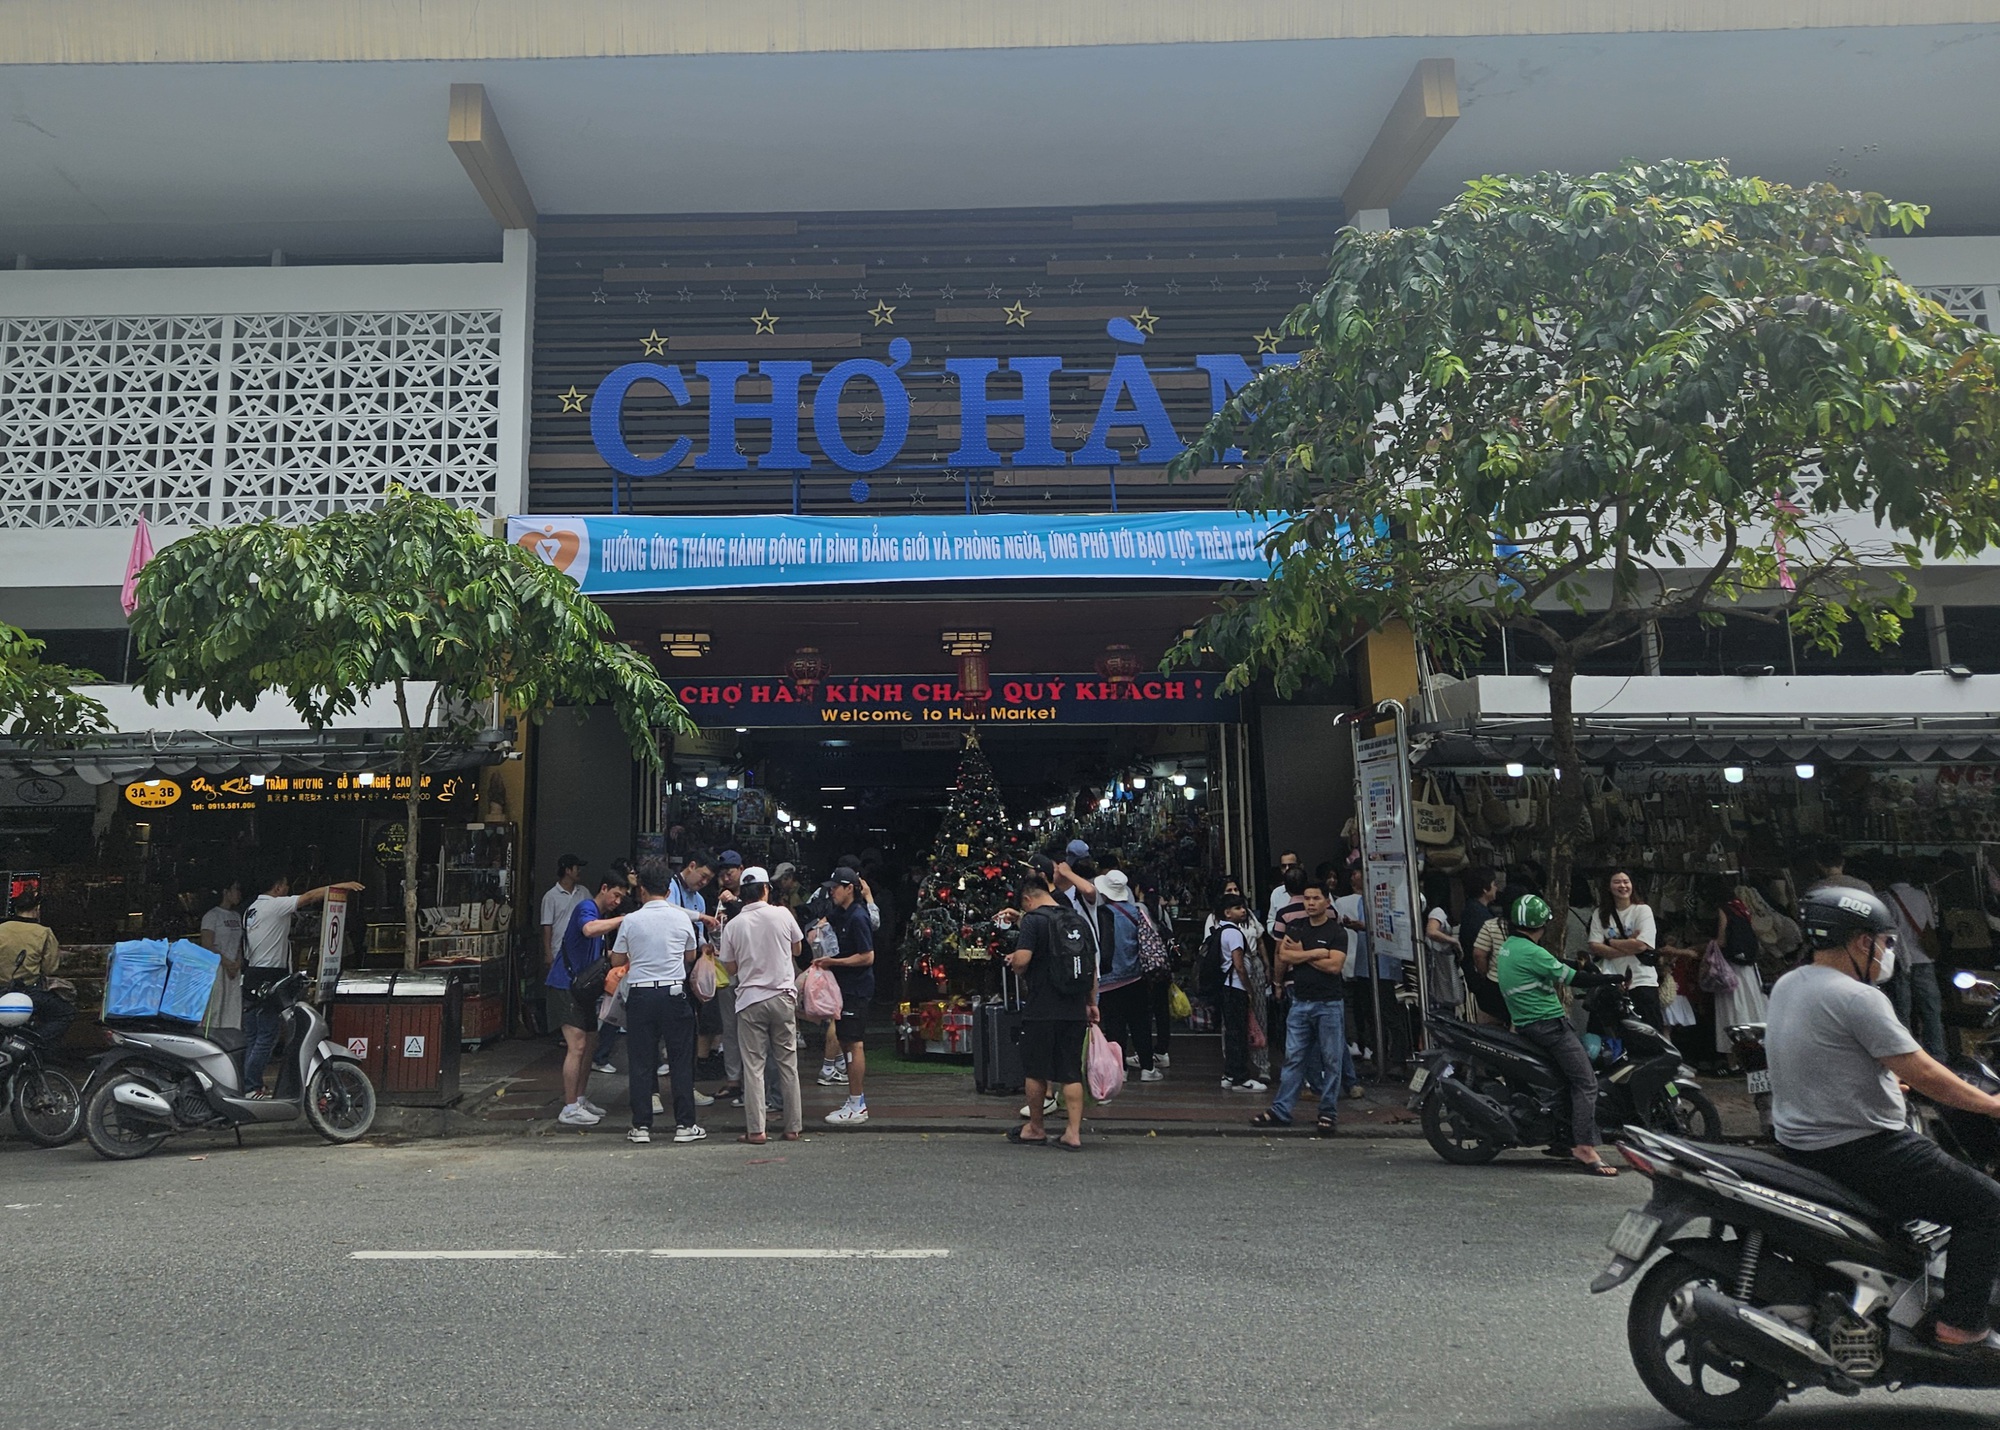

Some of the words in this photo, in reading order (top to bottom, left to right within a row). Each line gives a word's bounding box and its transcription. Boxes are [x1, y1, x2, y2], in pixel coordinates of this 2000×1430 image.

[590, 337, 913, 503] CHỢ
[601, 528, 647, 573] HƯỞNG
[650, 534, 679, 570] ỨNG
[682, 533, 726, 569] THÁNG
[728, 533, 766, 567] HÀNH
[768, 532, 806, 574] ĐỘNG
[809, 533, 823, 564] VÌ
[826, 533, 859, 564] BÌNH
[861, 523, 900, 562] ĐẲNG
[902, 531, 930, 561] GIỚI
[932, 532, 952, 561] VÀ
[954, 531, 1001, 560] PHÒNG
[1004, 529, 1047, 564] NGỪA,
[1049, 528, 1079, 559] ỨNG
[1082, 527, 1108, 558] PHÓ
[1109, 527, 1135, 558] VỚI
[1138, 532, 1167, 566] BẠO
[1169, 529, 1195, 565] LỰC
[1196, 526, 1234, 561] TRÊN
[1236, 528, 1255, 561] CƠ
[679, 683, 743, 709] CHỢ
[825, 677, 903, 703] KÍNH
[911, 683, 993, 702] CH
[1003, 676, 1066, 704] QUÝ
[1194, 678, 1203, 699] !
[820, 708, 913, 722] Welcome
[922, 707, 943, 721] to
[990, 706, 1057, 721] Market
[292, 777, 324, 789] HƯƠNG
[352, 777, 365, 789] M
[395, 776, 412, 788] CAO
[131, 788, 147, 798] 3A
[159, 787, 175, 797] 3B
[191, 803, 205, 811] Tel:
[1417, 808, 1434, 818] HERE
[1420, 817, 1445, 826] COMES
[1417, 823, 1429, 832] THE
[1431, 825, 1447, 833] SUN
